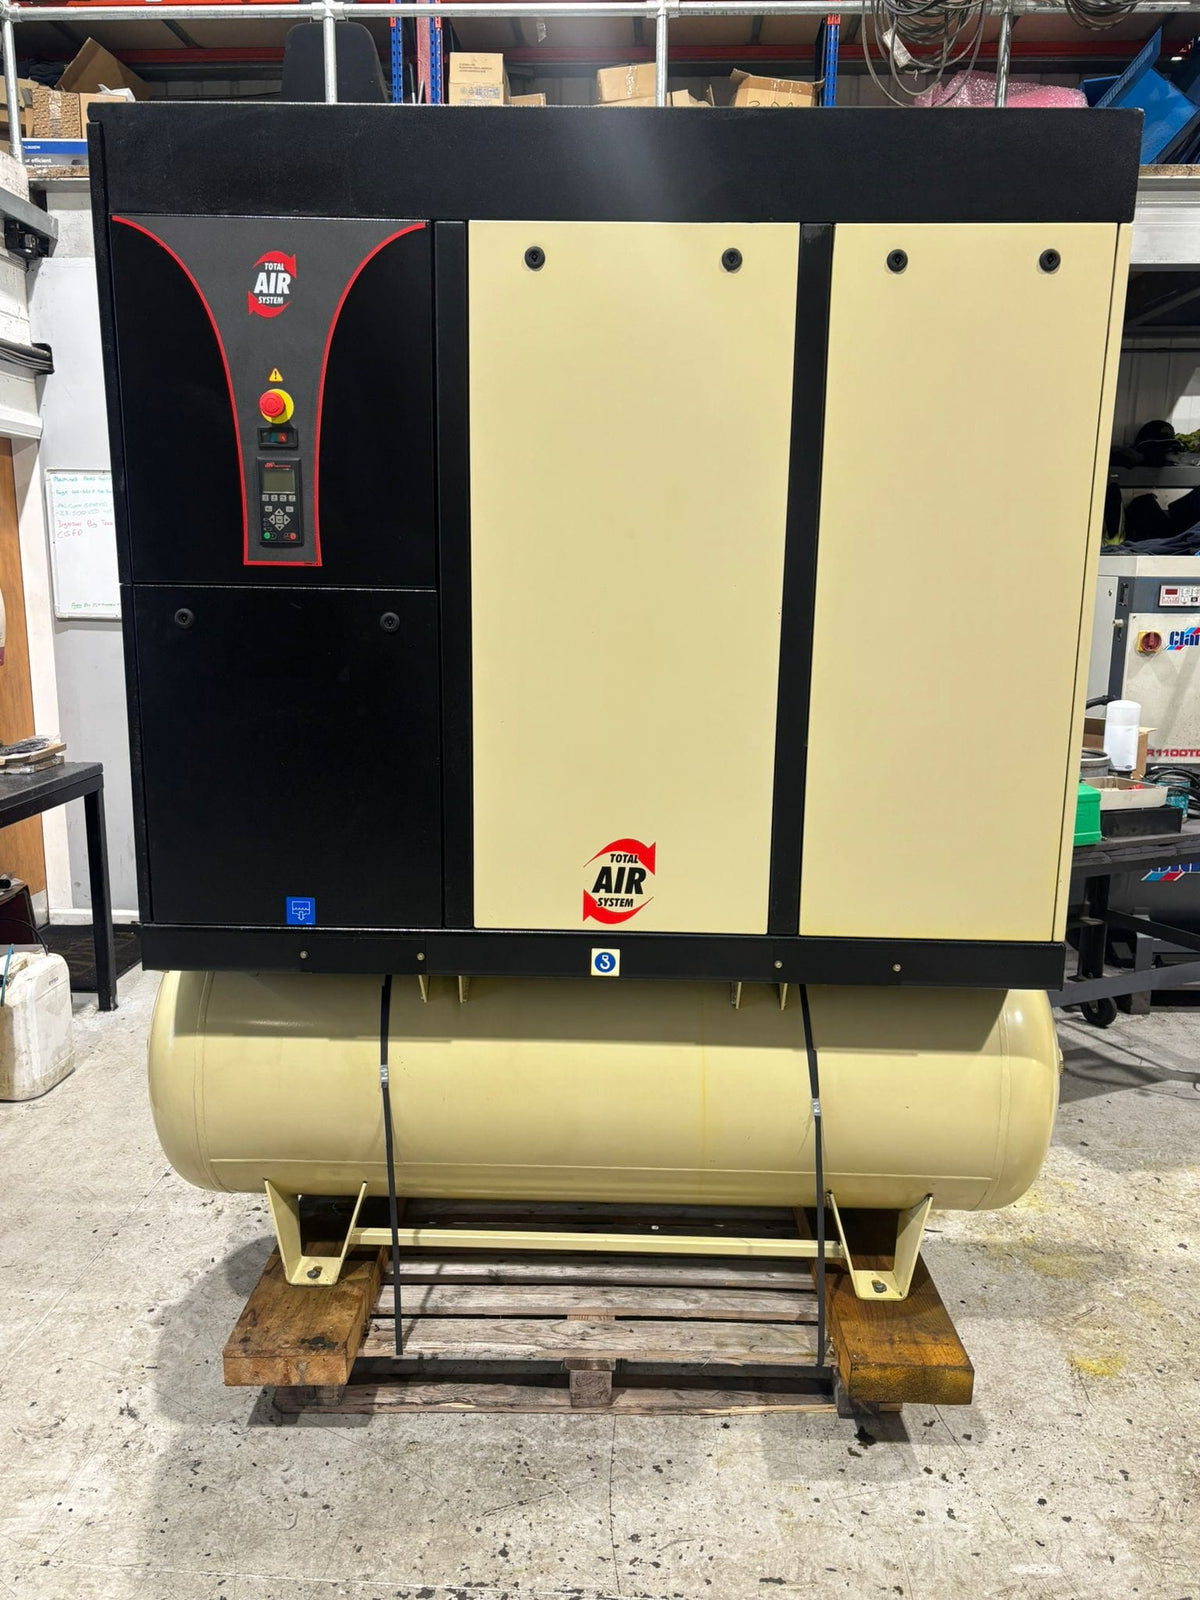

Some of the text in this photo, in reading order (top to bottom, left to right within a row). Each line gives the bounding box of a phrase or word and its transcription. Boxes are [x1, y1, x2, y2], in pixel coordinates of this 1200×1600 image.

[264, 262, 285, 271] TOTAL
[253, 272, 291, 294] AIR
[258, 296, 284, 304] SYSTEM
[610, 853, 639, 864] TOTAL
[591, 866, 647, 895] AIR
[597, 897, 634, 908] SYSTEM
